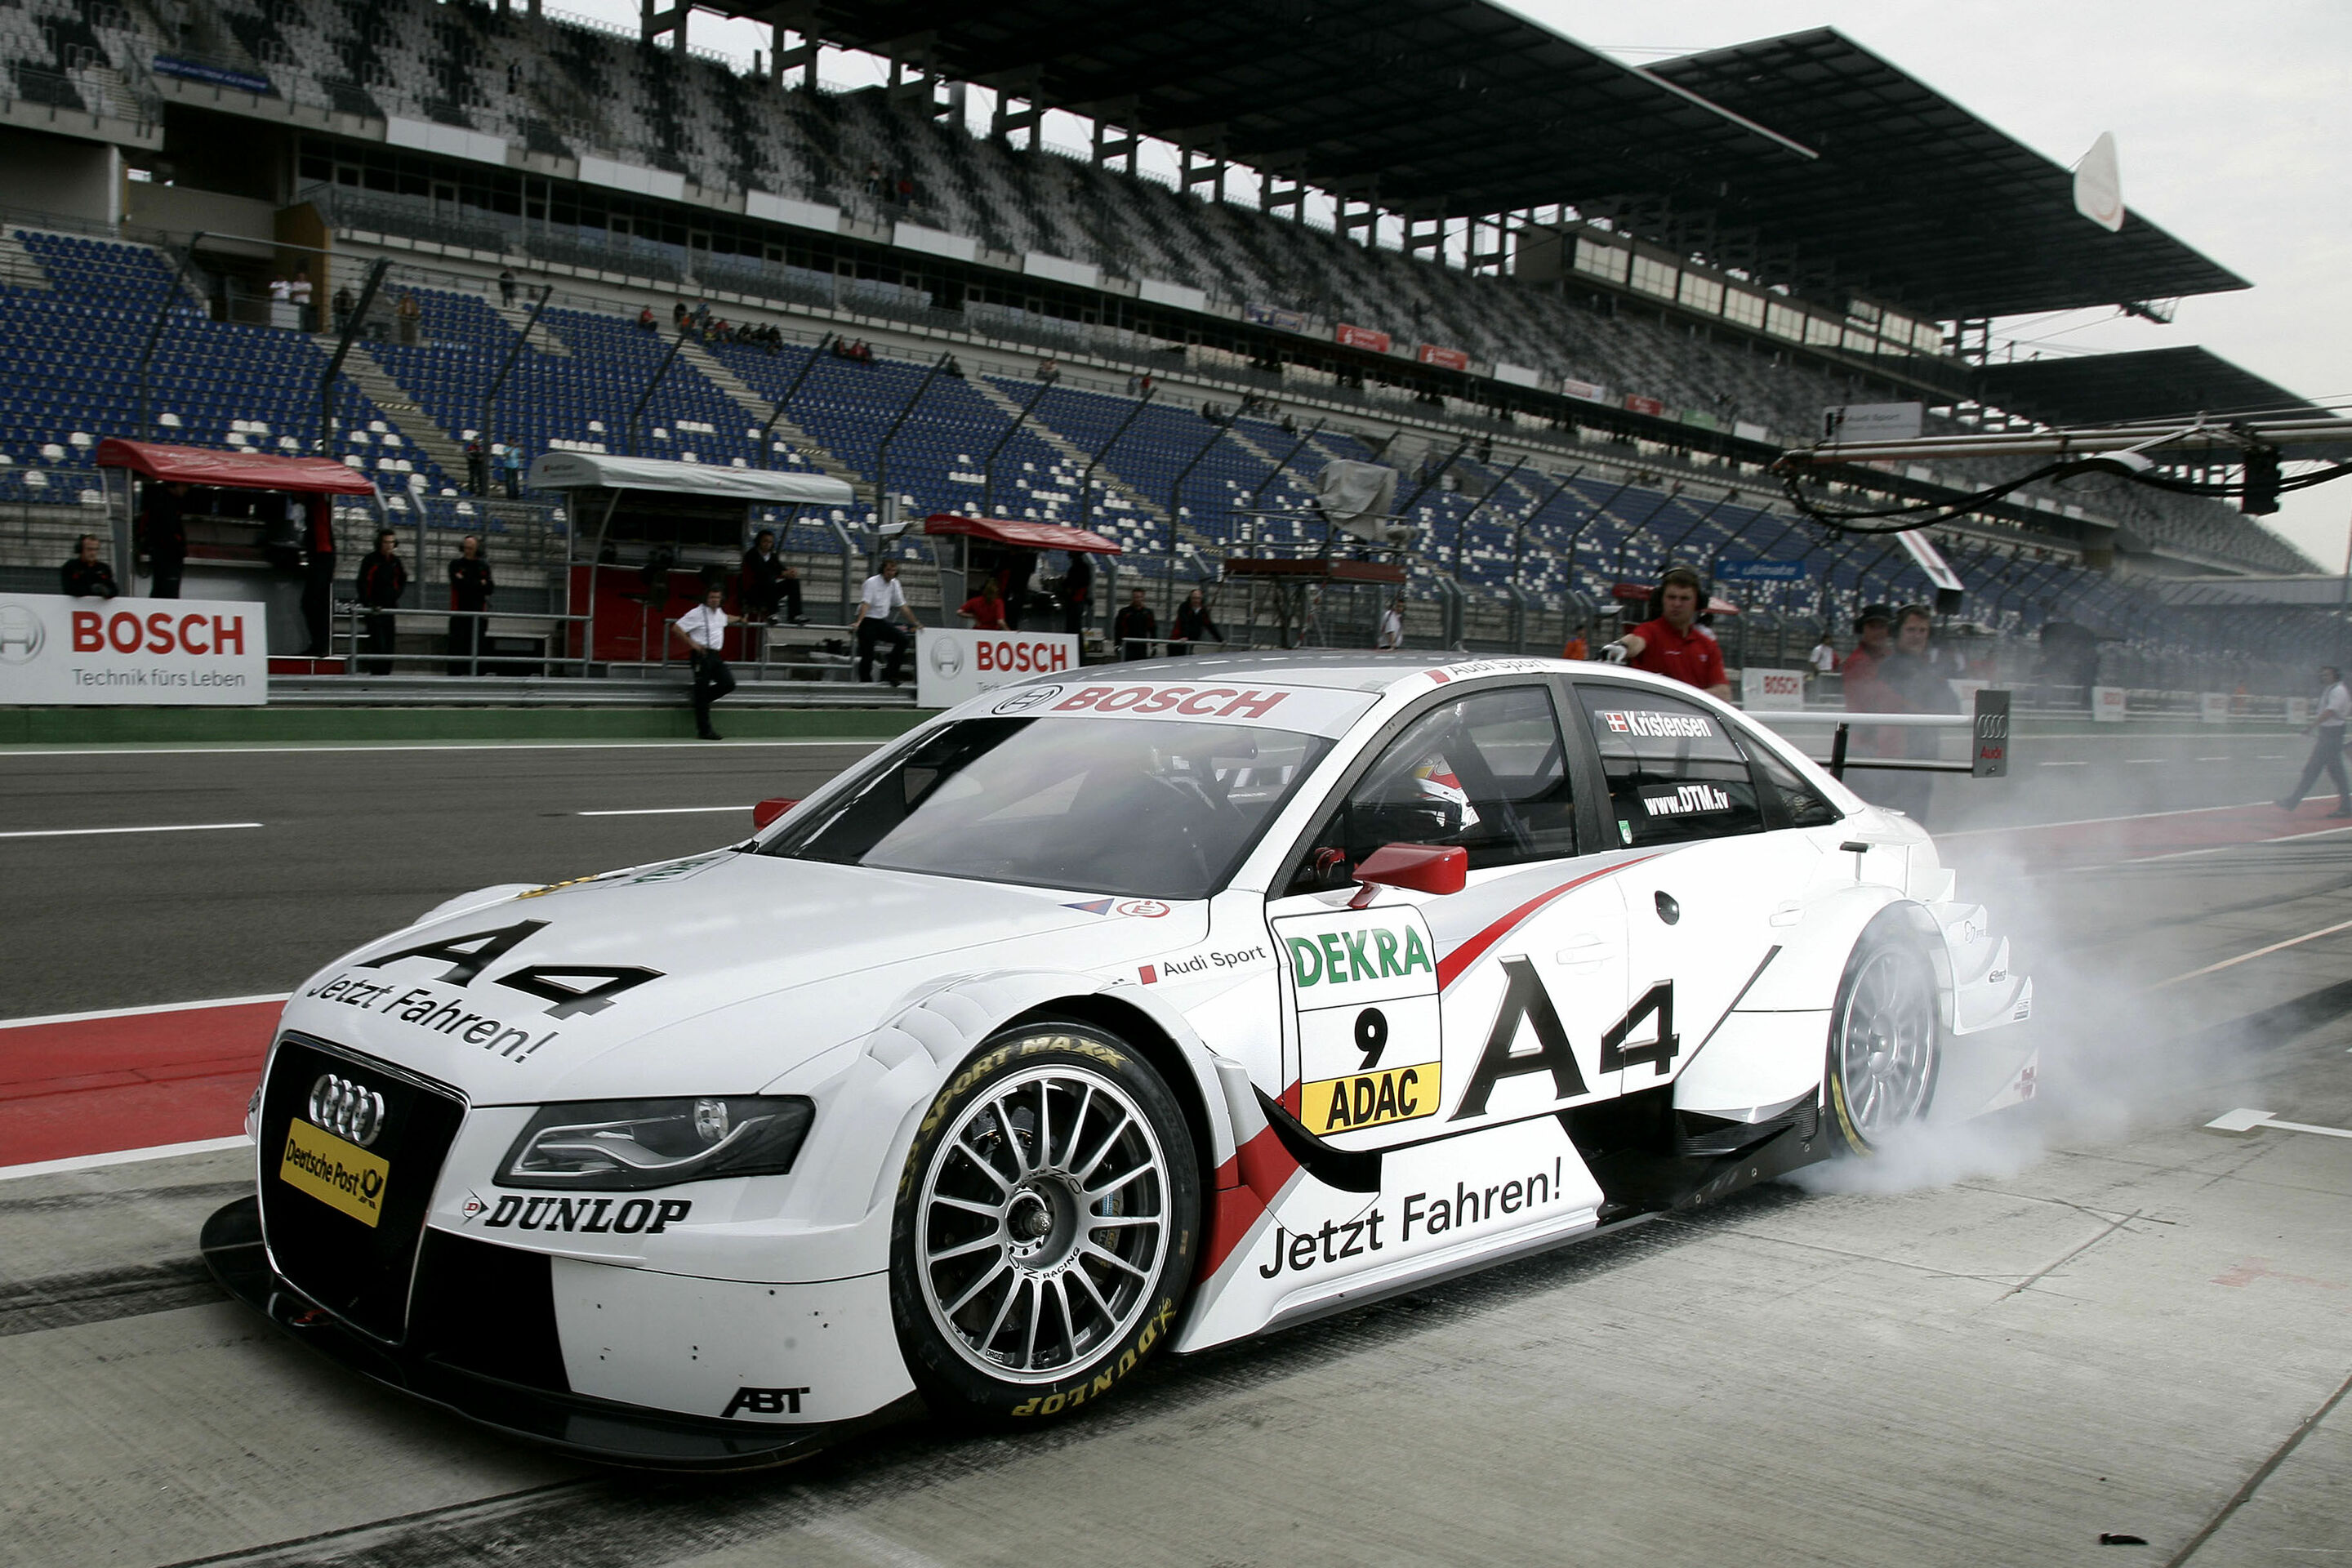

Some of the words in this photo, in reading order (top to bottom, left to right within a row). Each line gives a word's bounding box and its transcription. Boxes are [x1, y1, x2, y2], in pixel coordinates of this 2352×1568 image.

[72, 610, 245, 655] BOSCH
[976, 640, 1067, 672] BOSCH
[72, 668, 148, 687] Technik
[150, 669, 187, 687] fürs
[191, 670, 245, 688] Leben
[1764, 675, 1798, 695] BOSCH
[1049, 686, 1291, 719] BOSCH
[1624, 710, 1713, 737] Kristensen
[1980, 745, 2002, 760] Audi
[1643, 784, 1729, 817] www.DTM.tv
[352, 918, 668, 1021] A4
[1163, 955, 1209, 977] Audi
[1210, 945, 1267, 969] Sport
[1285, 924, 1433, 988] DEKRA
[305, 973, 396, 1011] Jetzt
[380, 987, 561, 1064] Fahren!
[1446, 953, 1680, 1123] A4
[1019, 1034, 1135, 1072] MAXX
[1354, 1007, 1388, 1071] 9
[1325, 1068, 1419, 1131] ADAC
[285, 1138, 334, 1183] Deutsche
[332, 1160, 360, 1197] Post
[483, 1195, 693, 1235] DUNLOP
[1258, 1208, 1384, 1281] Jetzt
[1401, 1156, 1561, 1243] Fahren!
[1042, 1246, 1080, 1280] RACING
[1010, 1317, 1158, 1417] DUNLOP
[719, 1386, 811, 1419] ABT
